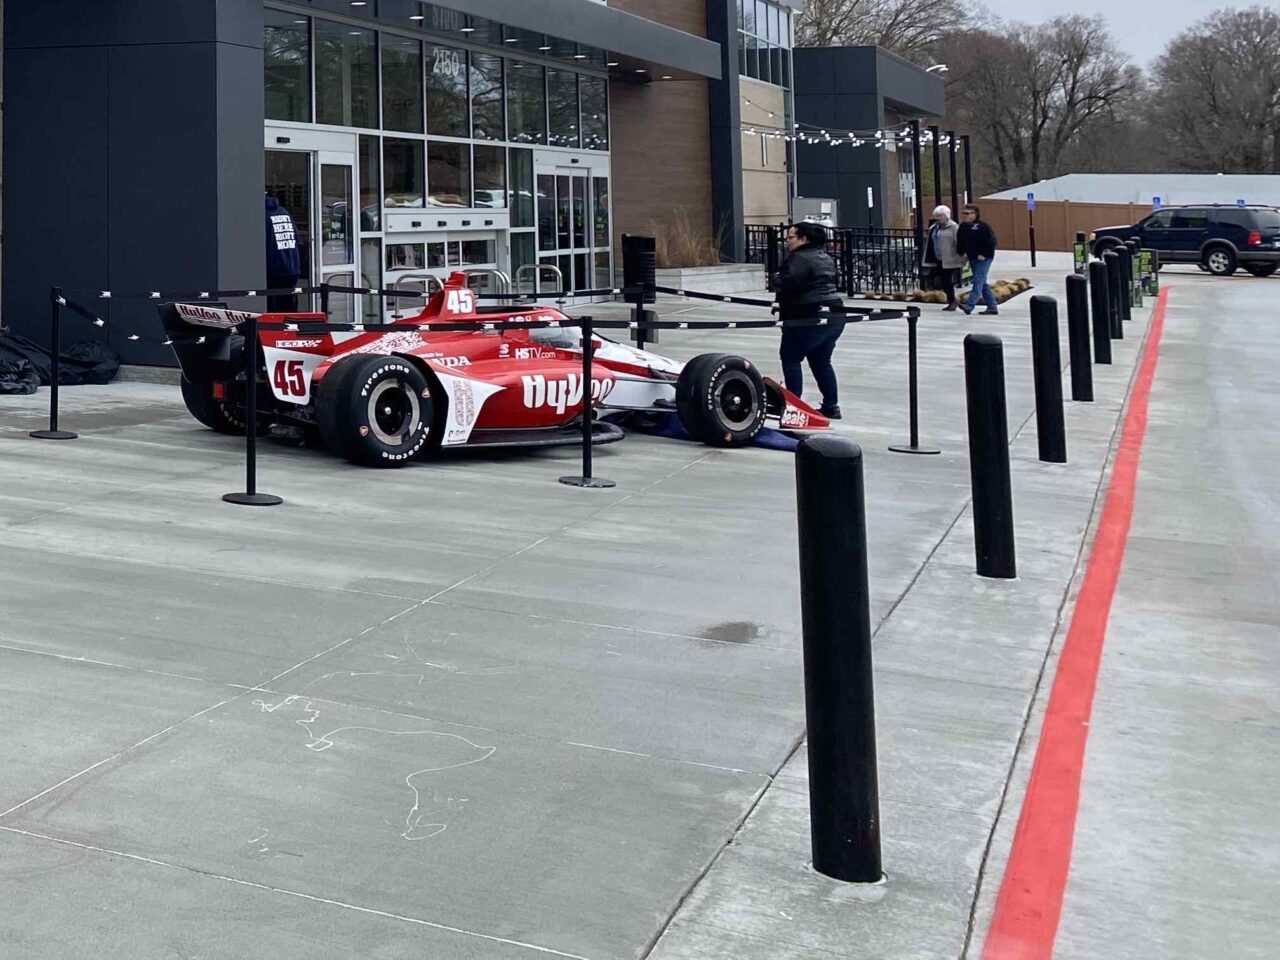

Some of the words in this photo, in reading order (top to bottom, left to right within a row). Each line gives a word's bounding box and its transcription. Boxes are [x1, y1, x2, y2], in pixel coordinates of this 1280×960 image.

[273, 223, 294, 233] HERE
[275, 232, 295, 241] RIGHT
[276, 240, 296, 250] NOW
[446, 288, 474, 315] 45
[273, 359, 308, 397] 45
[360, 364, 411, 398] Firestone
